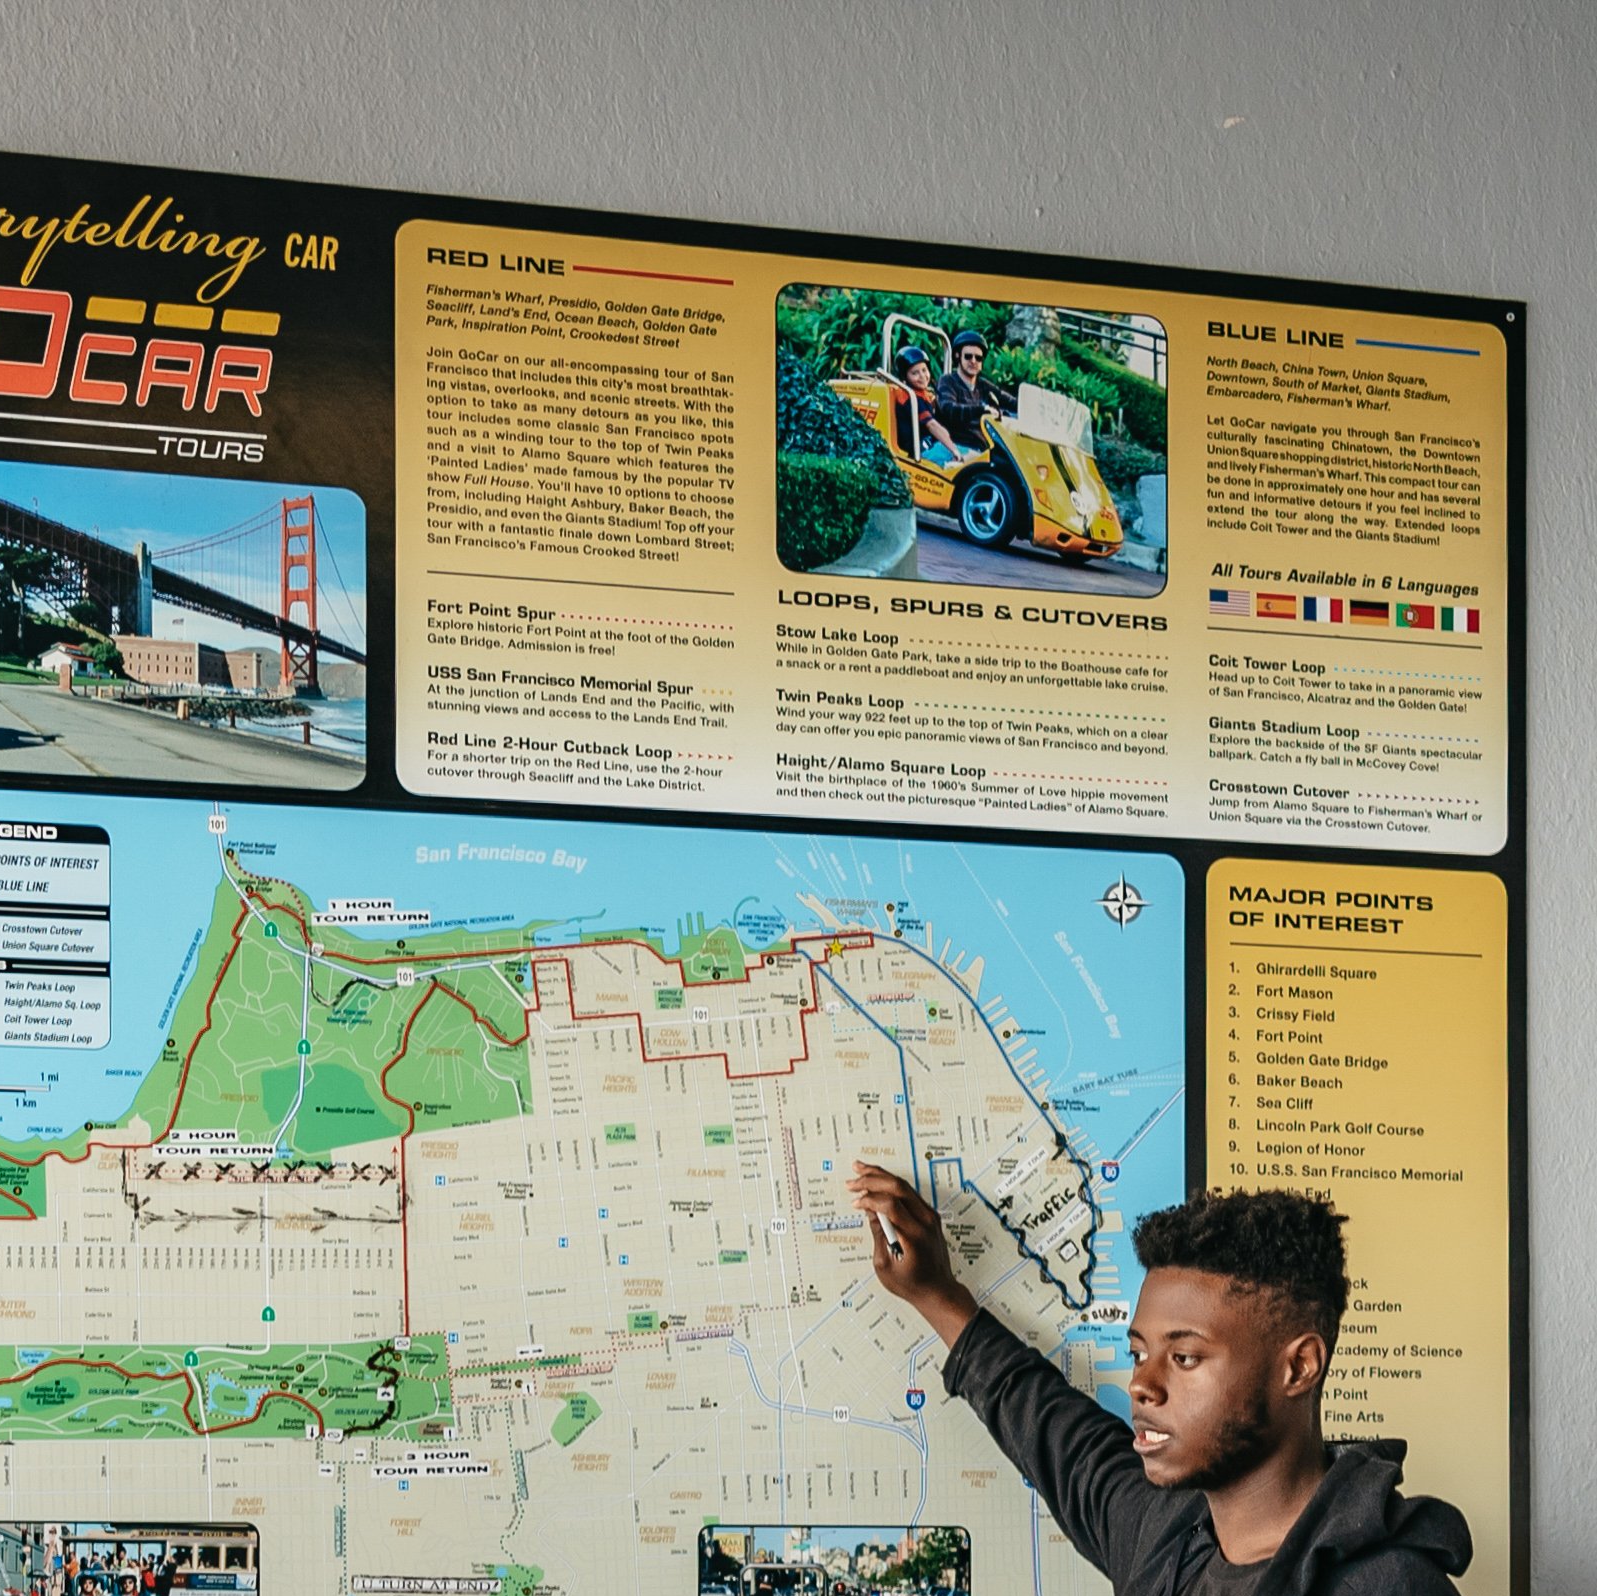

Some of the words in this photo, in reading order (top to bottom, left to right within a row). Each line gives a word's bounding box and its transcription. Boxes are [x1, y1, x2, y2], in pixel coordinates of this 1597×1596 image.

[283, 232, 339, 271] CAR
[427, 247, 488, 268] RED
[500, 254, 564, 276] LINE
[426, 284, 501, 300] Fisherman's
[505, 290, 544, 306] Wharf,
[548, 294, 600, 311] Presidio,
[604, 300, 647, 314] Golden
[651, 304, 679, 317] Gate
[682, 307, 725, 323] Bridge,
[1207, 320, 1276, 342] BLUE
[1286, 328, 1344, 348] LINE
[426, 346, 453, 358] Join
[458, 348, 498, 362] GoCar
[503, 355, 519, 364] on
[524, 356, 545, 366] our
[550, 357, 659, 373] all-encompassing
[664, 367, 689, 379] tour
[693, 370, 706, 380] of
[711, 371, 734, 383] San
[1206, 355, 1238, 368] North
[1240, 358, 1278, 373] Beach,
[1282, 362, 1314, 375] China
[1317, 365, 1348, 380] Town,
[1352, 368, 1384, 381] Union
[1386, 371, 1427, 387] Square,
[157, 435, 265, 464] TOURS
[1211, 563, 1233, 577] All
[1239, 564, 1281, 580] Tours
[1286, 568, 1357, 586] Available
[1361, 573, 1375, 588] in
[1381, 575, 1392, 589] 6
[1397, 576, 1478, 596] Languages
[427, 599, 463, 614] Fort
[469, 601, 511, 617] Point
[517, 605, 556, 622] Spur
[778, 589, 878, 614] LOOPS,
[890, 597, 983, 618] SPURS
[994, 604, 1012, 620] &
[1022, 607, 1167, 631] CUTOVERS
[776, 624, 816, 638] Stow
[821, 626, 857, 641] Lake
[863, 629, 898, 647] Loop
[1208, 654, 1238, 668] Coit
[1243, 656, 1287, 671] Tower
[1292, 659, 1325, 676] Loop
[427, 665, 461, 679] USS
[466, 667, 496, 682] San
[501, 670, 575, 687] Francisco
[580, 675, 651, 692] Memorial
[656, 680, 693, 697] Spur
[775, 688, 810, 702] Twin
[816, 690, 862, 705] Peaks
[868, 693, 904, 711] Loop
[1208, 716, 1256, 730] Giants
[1261, 719, 1321, 735] Stadium
[1326, 723, 1359, 740] Loop
[427, 731, 457, 745] Red
[464, 733, 496, 747] Line
[503, 736, 557, 751] 2-Hour
[563, 739, 628, 756] Cutback
[635, 743, 672, 761] Loop
[776, 753, 885, 771] Haight/Alamo
[890, 759, 945, 776] Square
[950, 762, 986, 780] Loop
[1209, 779, 1287, 795] Crosstown
[1293, 783, 1350, 798] Cutover
[210, 819, 225, 831] 101
[33, 856, 47, 867] OF
[49, 856, 99, 869] INTEREST
[415, 845, 450, 865] San
[458, 842, 546, 866] Francisco
[551, 846, 588, 874] Bay
[1229, 885, 1325, 905] MAJOR
[1336, 891, 1433, 911] POINTS
[366, 913, 429, 922] RETURN
[1229, 910, 1264, 926] OF
[1274, 912, 1403, 934] INTEREST
[398, 970, 414, 983] 101
[1229, 961, 1239, 973] 1.
[1255, 962, 1325, 977] Ghirardelli
[1330, 965, 1377, 980] Square
[1228, 1005, 1240, 1018] 3.
[1256, 1006, 1299, 1023] Crissy
[1302, 1008, 1335, 1022] Field
[1228, 1051, 1239, 1062] 5.
[1256, 1052, 1304, 1065] Golden
[1308, 1054, 1340, 1066] Gate
[1344, 1055, 1388, 1071] Bridge
[1228, 1118, 1240, 1129] 8.
[1256, 1118, 1305, 1131] Lincoln
[1310, 1120, 1340, 1133] Park
[1344, 1121, 1372, 1134] Golf
[1376, 1122, 1424, 1136] Course
[1230, 1163, 1248, 1174] 10.
[1256, 1163, 1297, 1176] U.S.S.
[1301, 1164, 1327, 1177] San
[1331, 1165, 1397, 1179] Francisco
[1401, 1167, 1463, 1181] Memorial
[1020, 1187, 1076, 1230] Traffic
[771, 1220, 788, 1233] 101
[1092, 1308, 1129, 1321] GIANTS
[1353, 1299, 1401, 1312] Garden
[1392, 1345, 1406, 1356] of
[1410, 1345, 1463, 1357] Science
[1324, 1410, 1352, 1422] Fine
[1356, 1410, 1384, 1422] Arts
[424, 1451, 469, 1459] HOUR
[373, 1467, 417, 1475] TOUR
[426, 1465, 488, 1474] RETURN
[379, 1579, 424, 1591] TURN
[430, 1580, 451, 1592] AT
